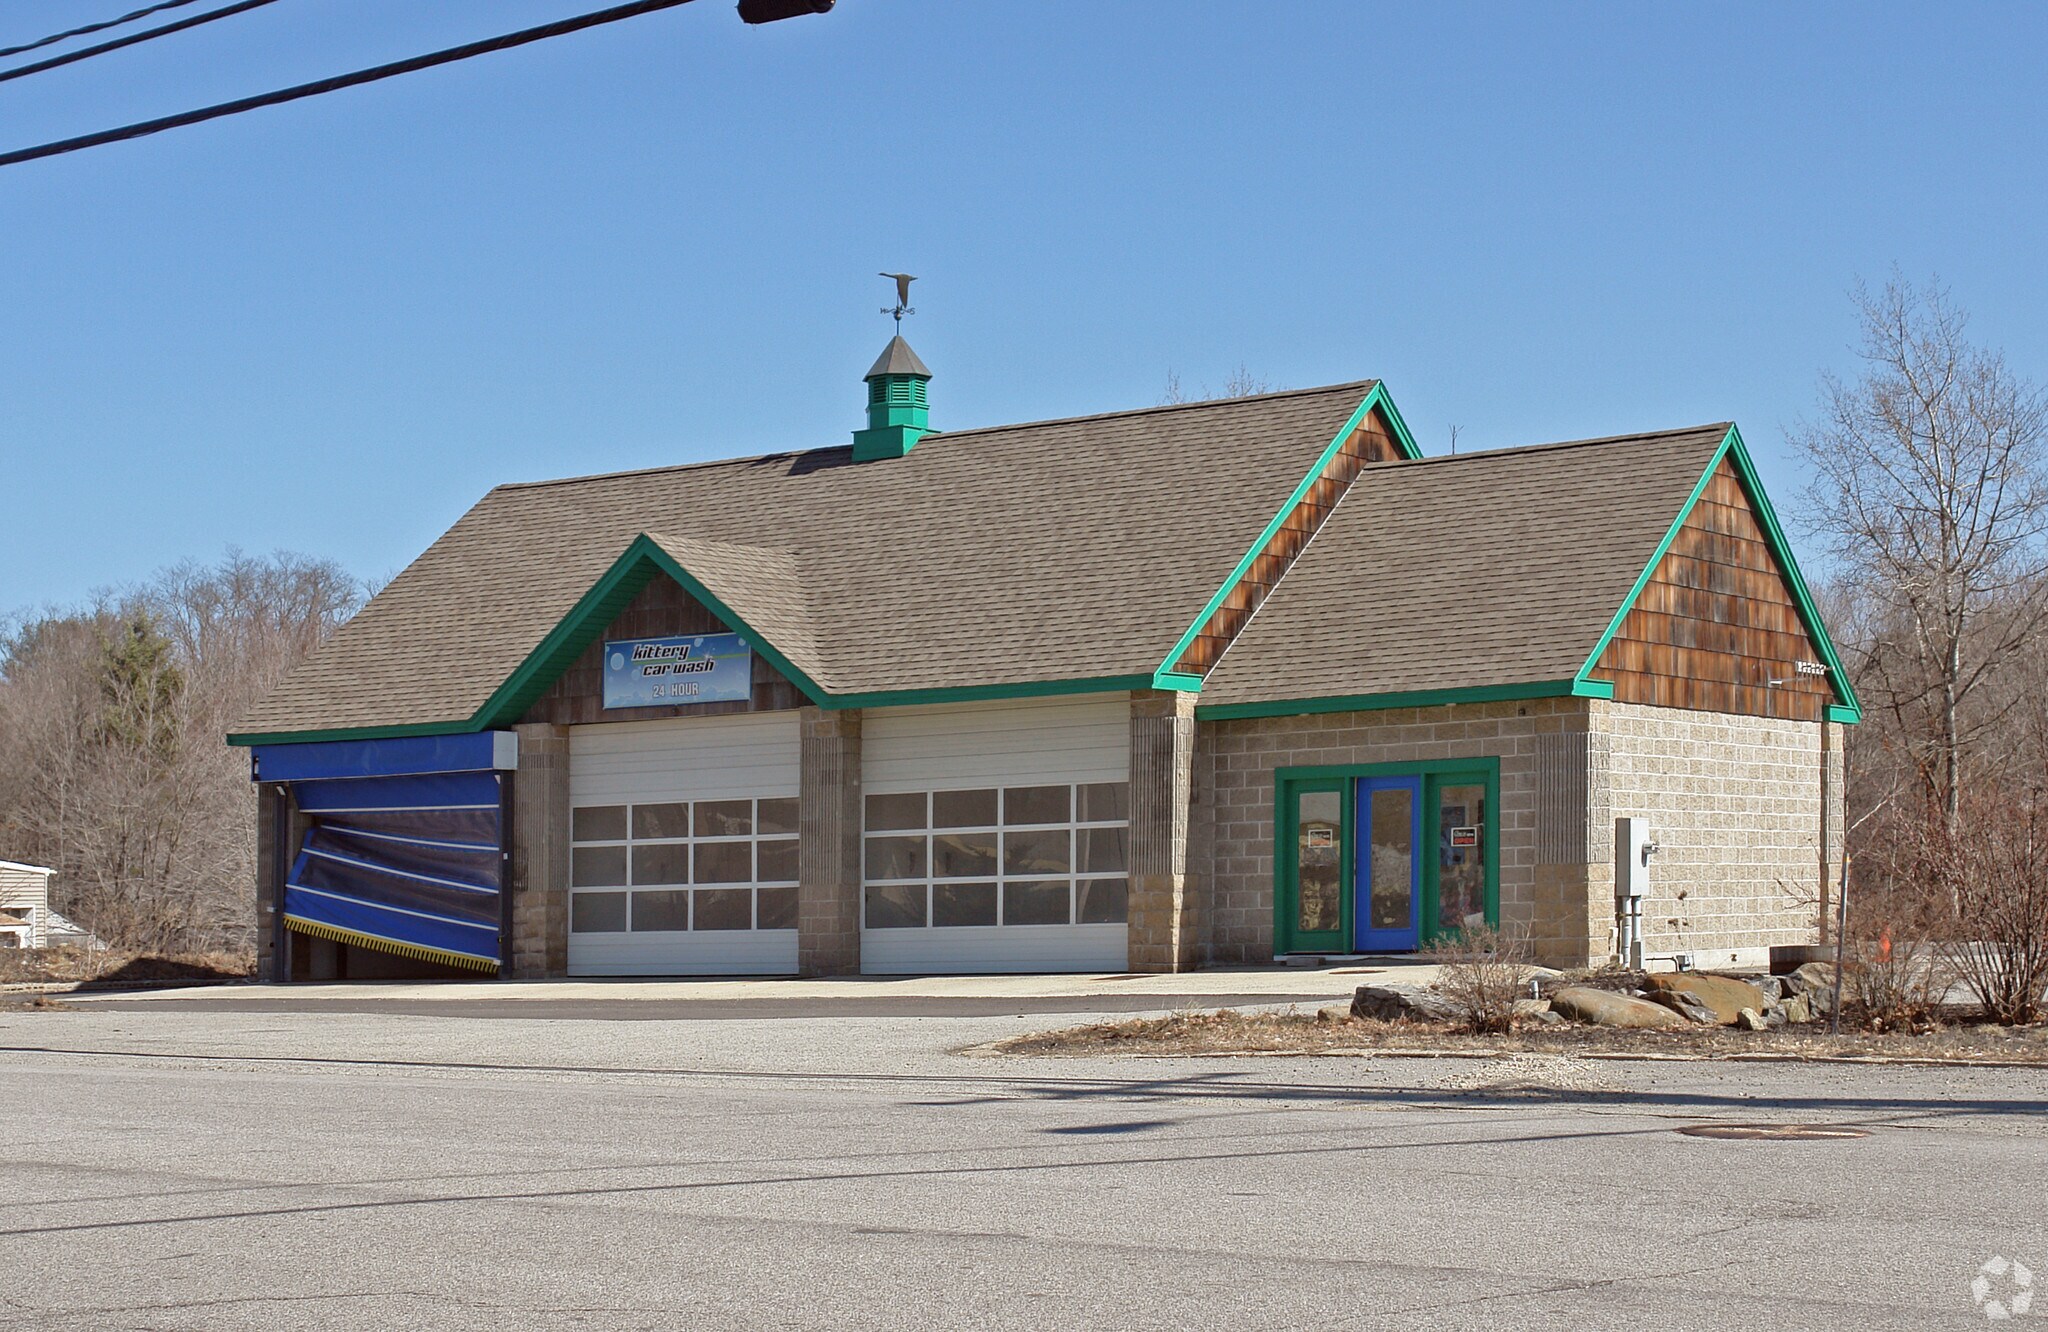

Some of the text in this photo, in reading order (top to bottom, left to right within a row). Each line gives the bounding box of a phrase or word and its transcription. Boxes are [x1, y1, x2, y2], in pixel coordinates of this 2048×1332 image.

[643, 658, 715, 676] car wash
[652, 682, 700, 698] 24 HOUR
